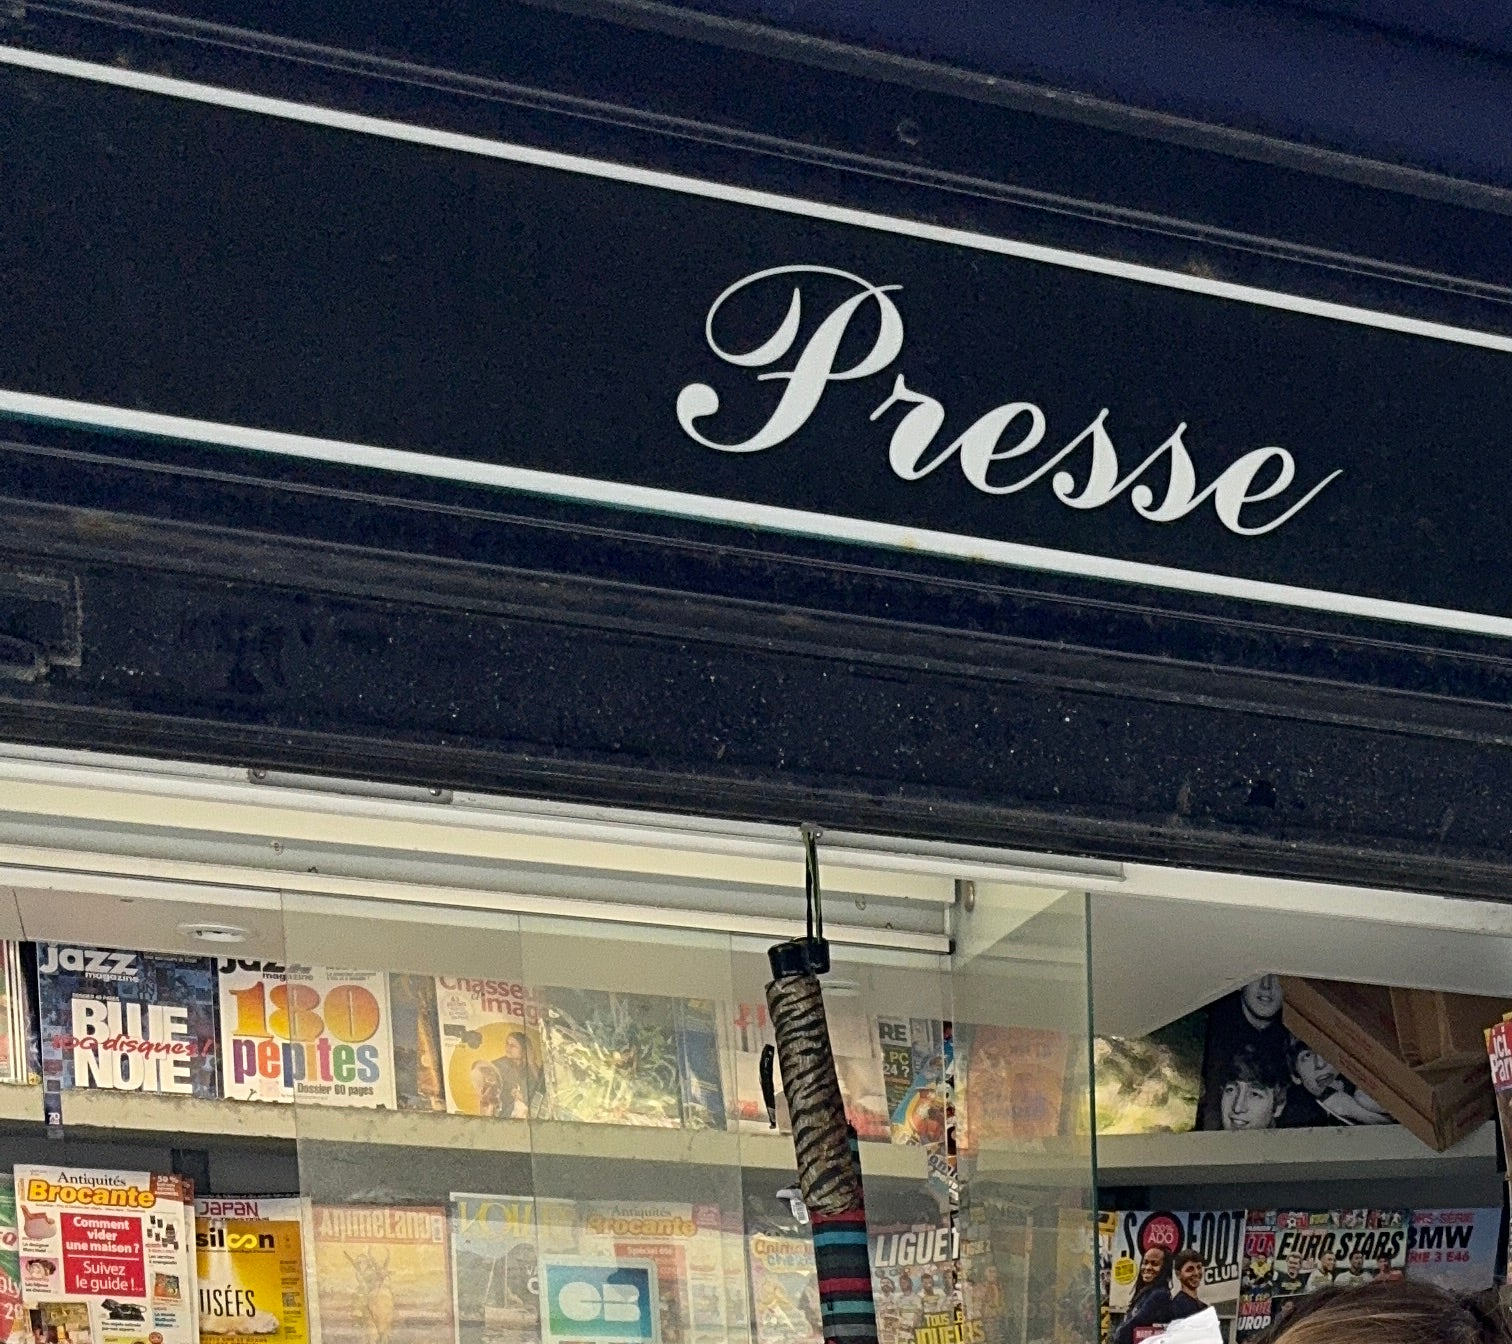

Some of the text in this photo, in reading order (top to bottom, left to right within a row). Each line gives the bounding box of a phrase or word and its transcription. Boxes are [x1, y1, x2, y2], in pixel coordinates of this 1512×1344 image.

[676, 264, 1342, 536] Presse
[71, 998, 188, 1040] BLUE
[233, 1037, 381, 1085] pépites
[74, 1054, 192, 1093] NOTE
[57, 1172, 127, 1187] Antiquités
[28, 1179, 156, 1207] Brocante
[73, 1216, 129, 1230] Comment
[87, 1230, 117, 1241] vider
[66, 1241, 130, 1253] une maison
[1340, 1230, 1405, 1261] STARS
[83, 1261, 125, 1276] Suivez
[1205, 1266, 1239, 1283] CLUB
[76, 1276, 128, 1292] le guide
